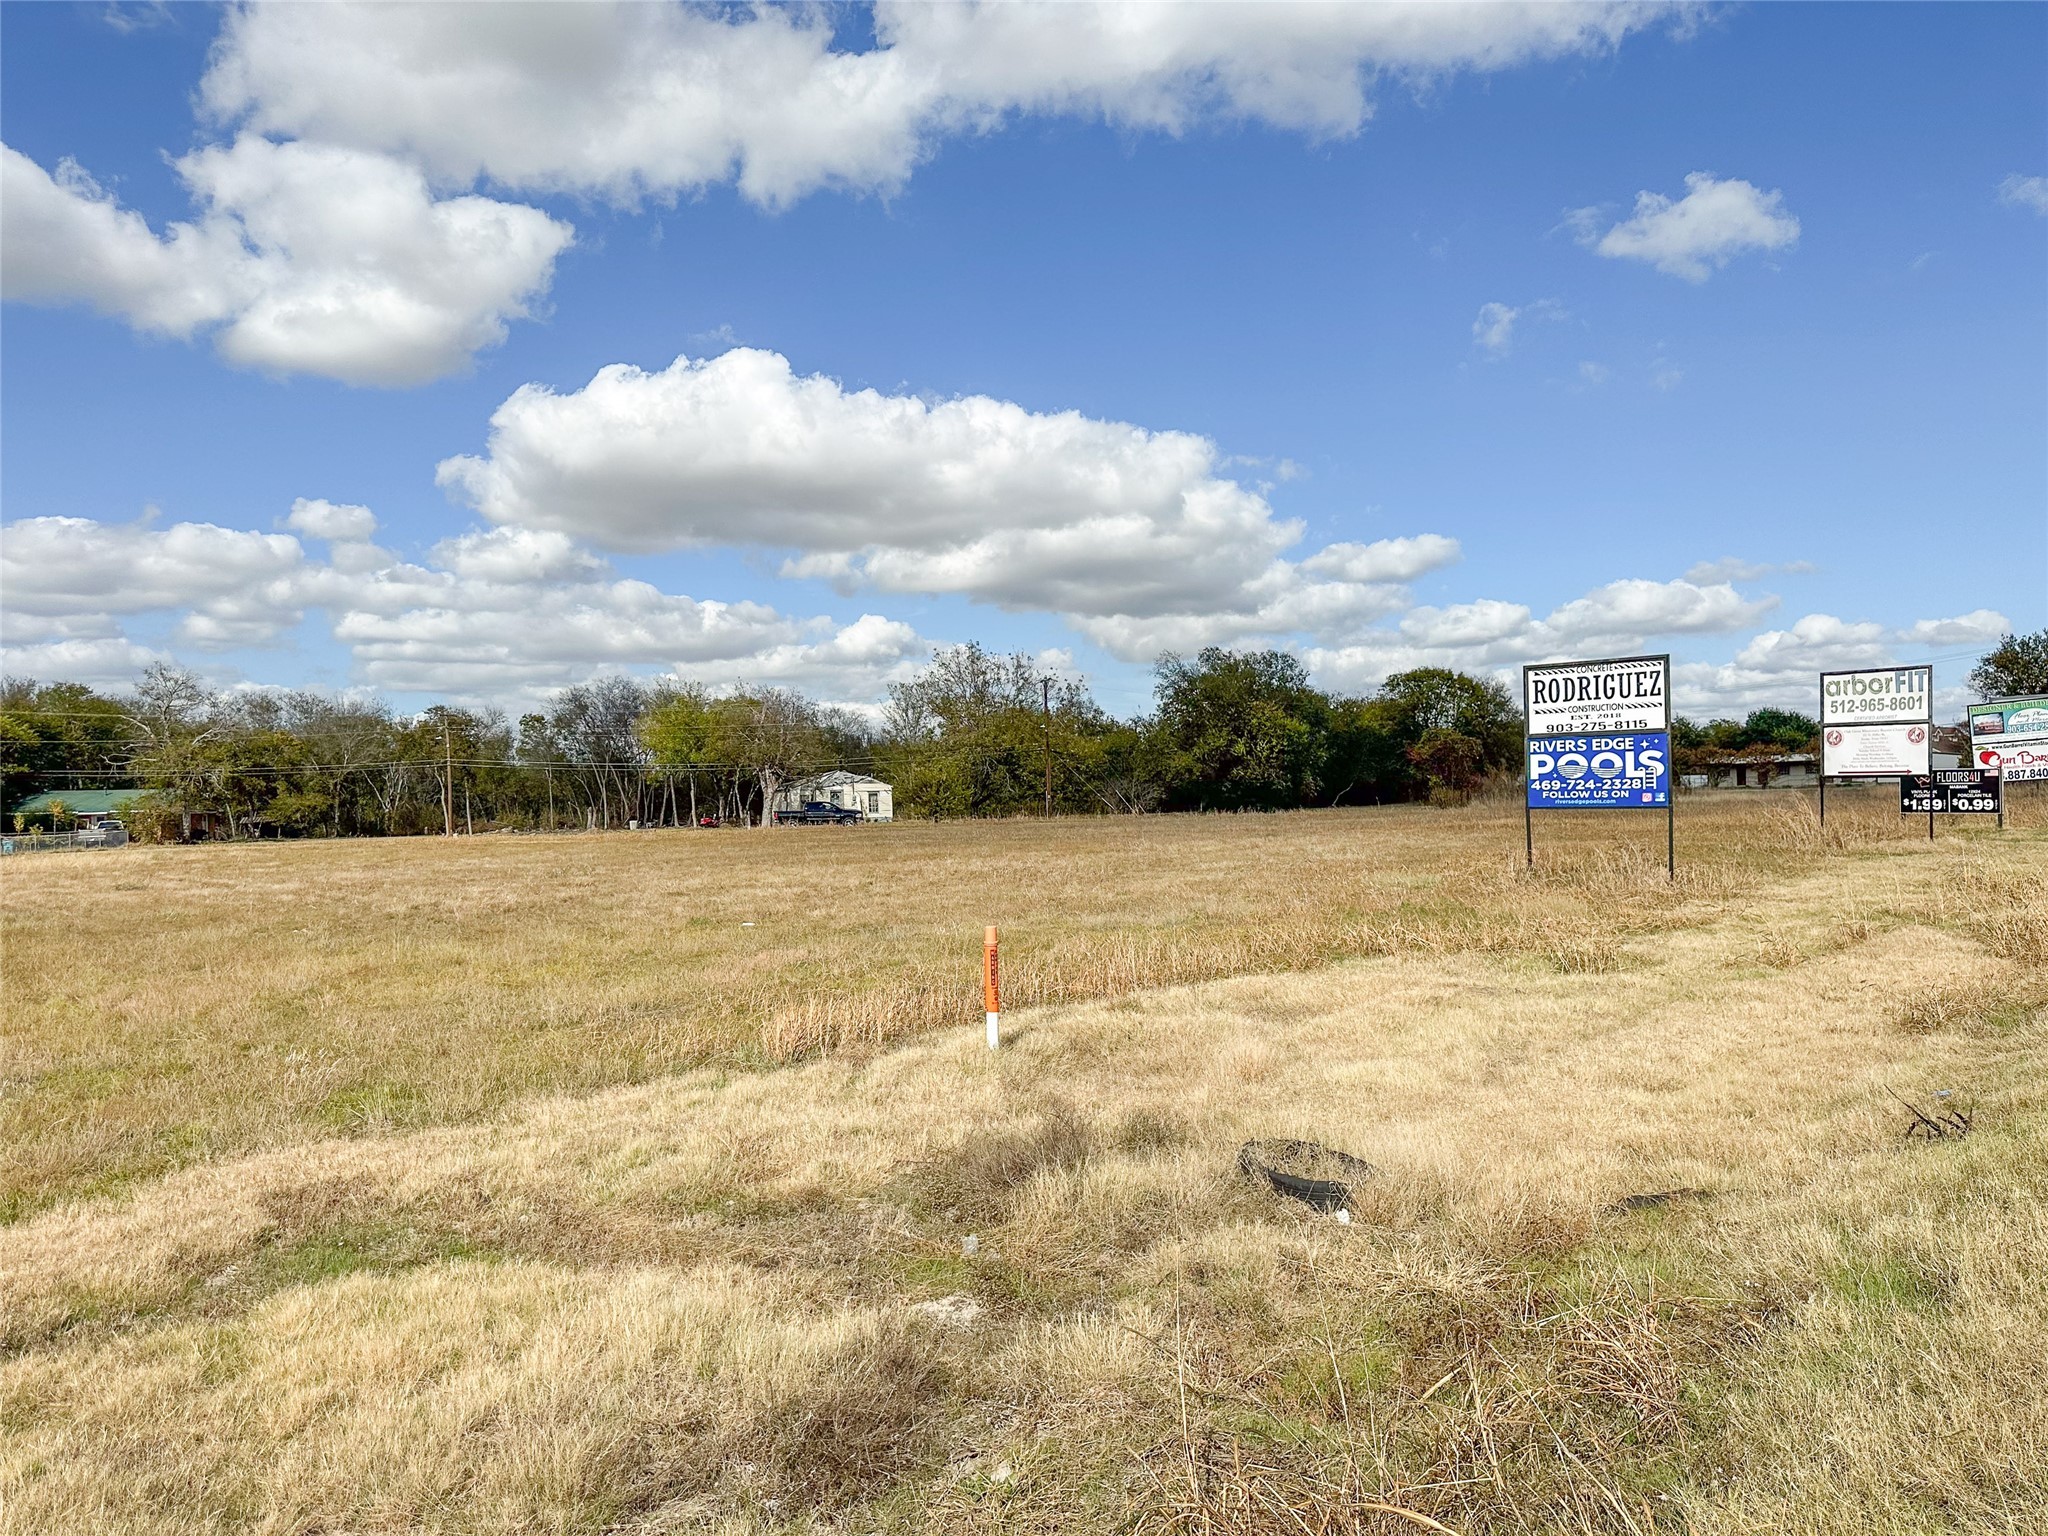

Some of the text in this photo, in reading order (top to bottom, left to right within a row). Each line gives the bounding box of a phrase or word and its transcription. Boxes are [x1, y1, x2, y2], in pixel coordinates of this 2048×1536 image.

[1576, 664, 1613, 674] CONCRETE
[1532, 670, 1662, 704] RODRIGUEZ
[1825, 670, 1928, 697] arborFIT
[1567, 703, 1624, 714] CONSTRUCTION
[1830, 695, 1923, 714] 512-965-8601
[1546, 719, 1648, 733] 903-275-8115
[1529, 737, 1634, 753] RIVERS EDGE
[1529, 749, 1665, 780] POOLS
[1936, 771, 1981, 783] FLOORS4U
[1530, 779, 1642, 790] 469-724-2328
[1542, 791, 1590, 799] FOLLOW
[1611, 790, 1629, 798] ON
[1903, 798, 1943, 811] $1.99
[1952, 798, 1995, 811] $0.99
